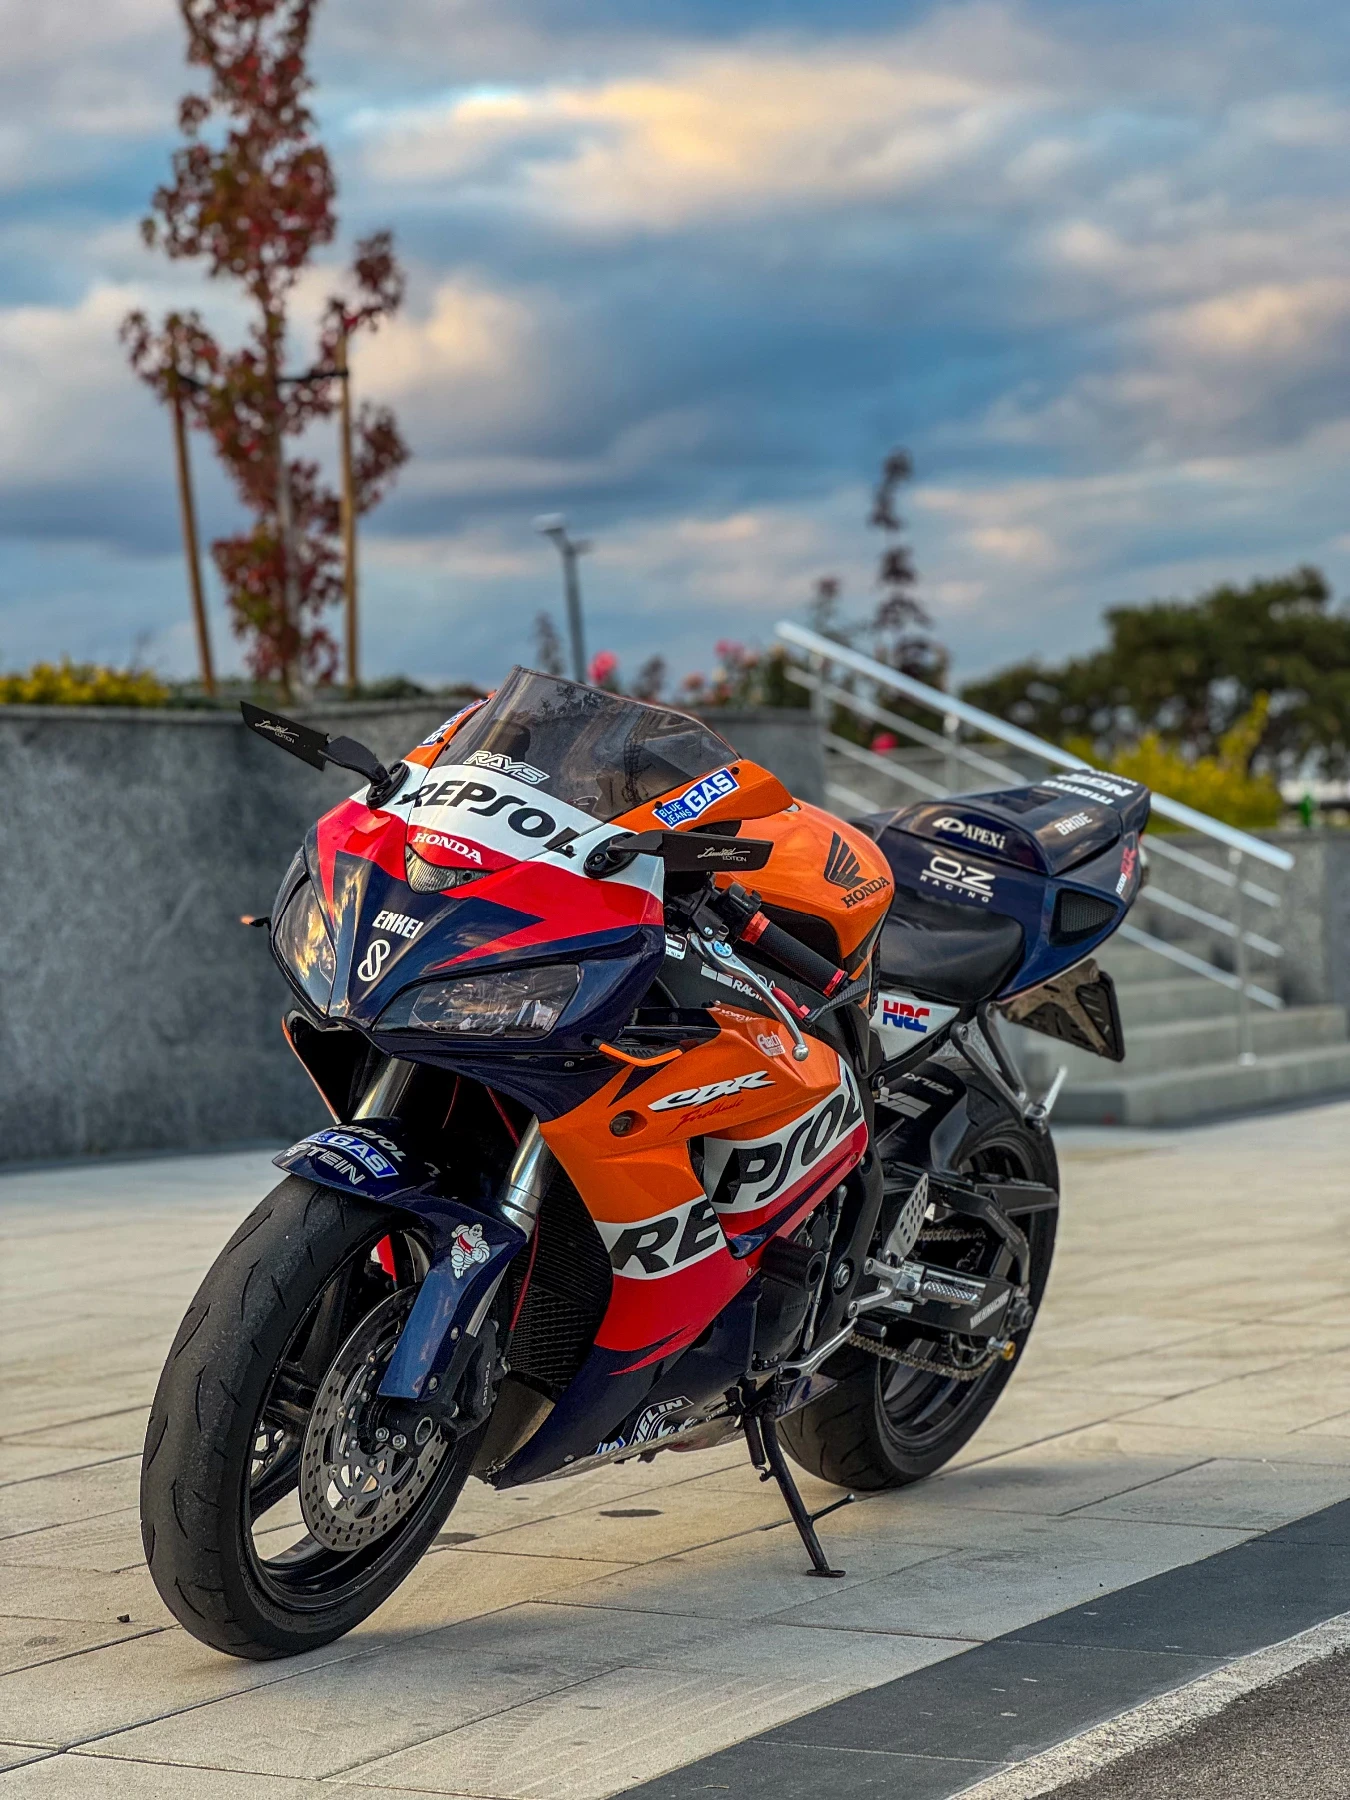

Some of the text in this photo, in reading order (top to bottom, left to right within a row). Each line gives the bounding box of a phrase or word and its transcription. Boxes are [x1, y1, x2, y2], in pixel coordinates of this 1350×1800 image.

[463, 749, 551, 785] RAYS
[684, 773, 733, 812] GAS
[393, 780, 578, 859] REPSOL
[658, 801, 683, 818] BLUE
[668, 808, 693, 825] JEANS
[1054, 812, 1093, 836] BRIDE
[412, 832, 483, 865] HONDA
[697, 846, 751, 858] Limited
[840, 876, 890, 909] HONDA
[920, 875, 990, 903] RACING
[372, 910, 424, 939] ENKEI
[882, 1000, 930, 1033] HRC
[647, 1070, 776, 1112] CBR
[326, 1135, 389, 1172] GAS
[482, 1361, 491, 1406] TOKICO
